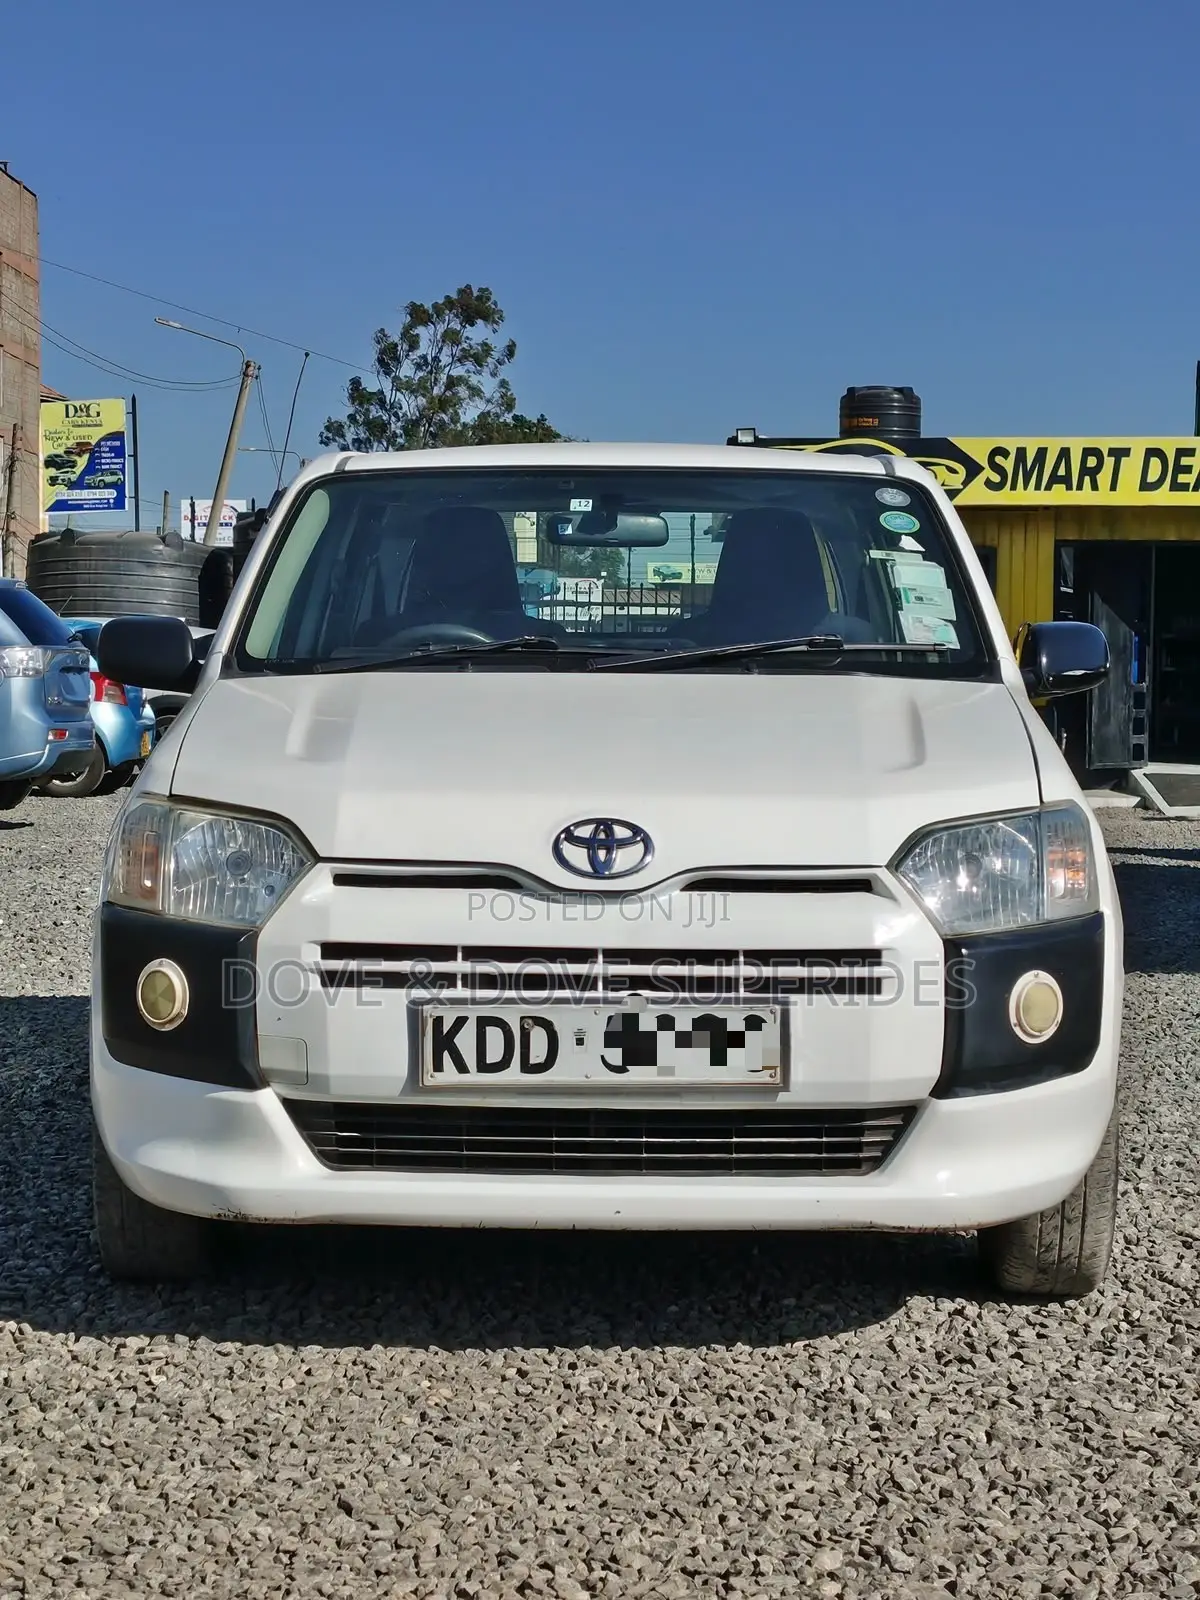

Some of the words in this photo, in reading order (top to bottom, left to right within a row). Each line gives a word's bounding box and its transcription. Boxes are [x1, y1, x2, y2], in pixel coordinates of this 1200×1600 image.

[65, 403, 101, 418] D&G
[984, 446, 1132, 492] SMART
[432, 1015, 560, 1075] KDD
